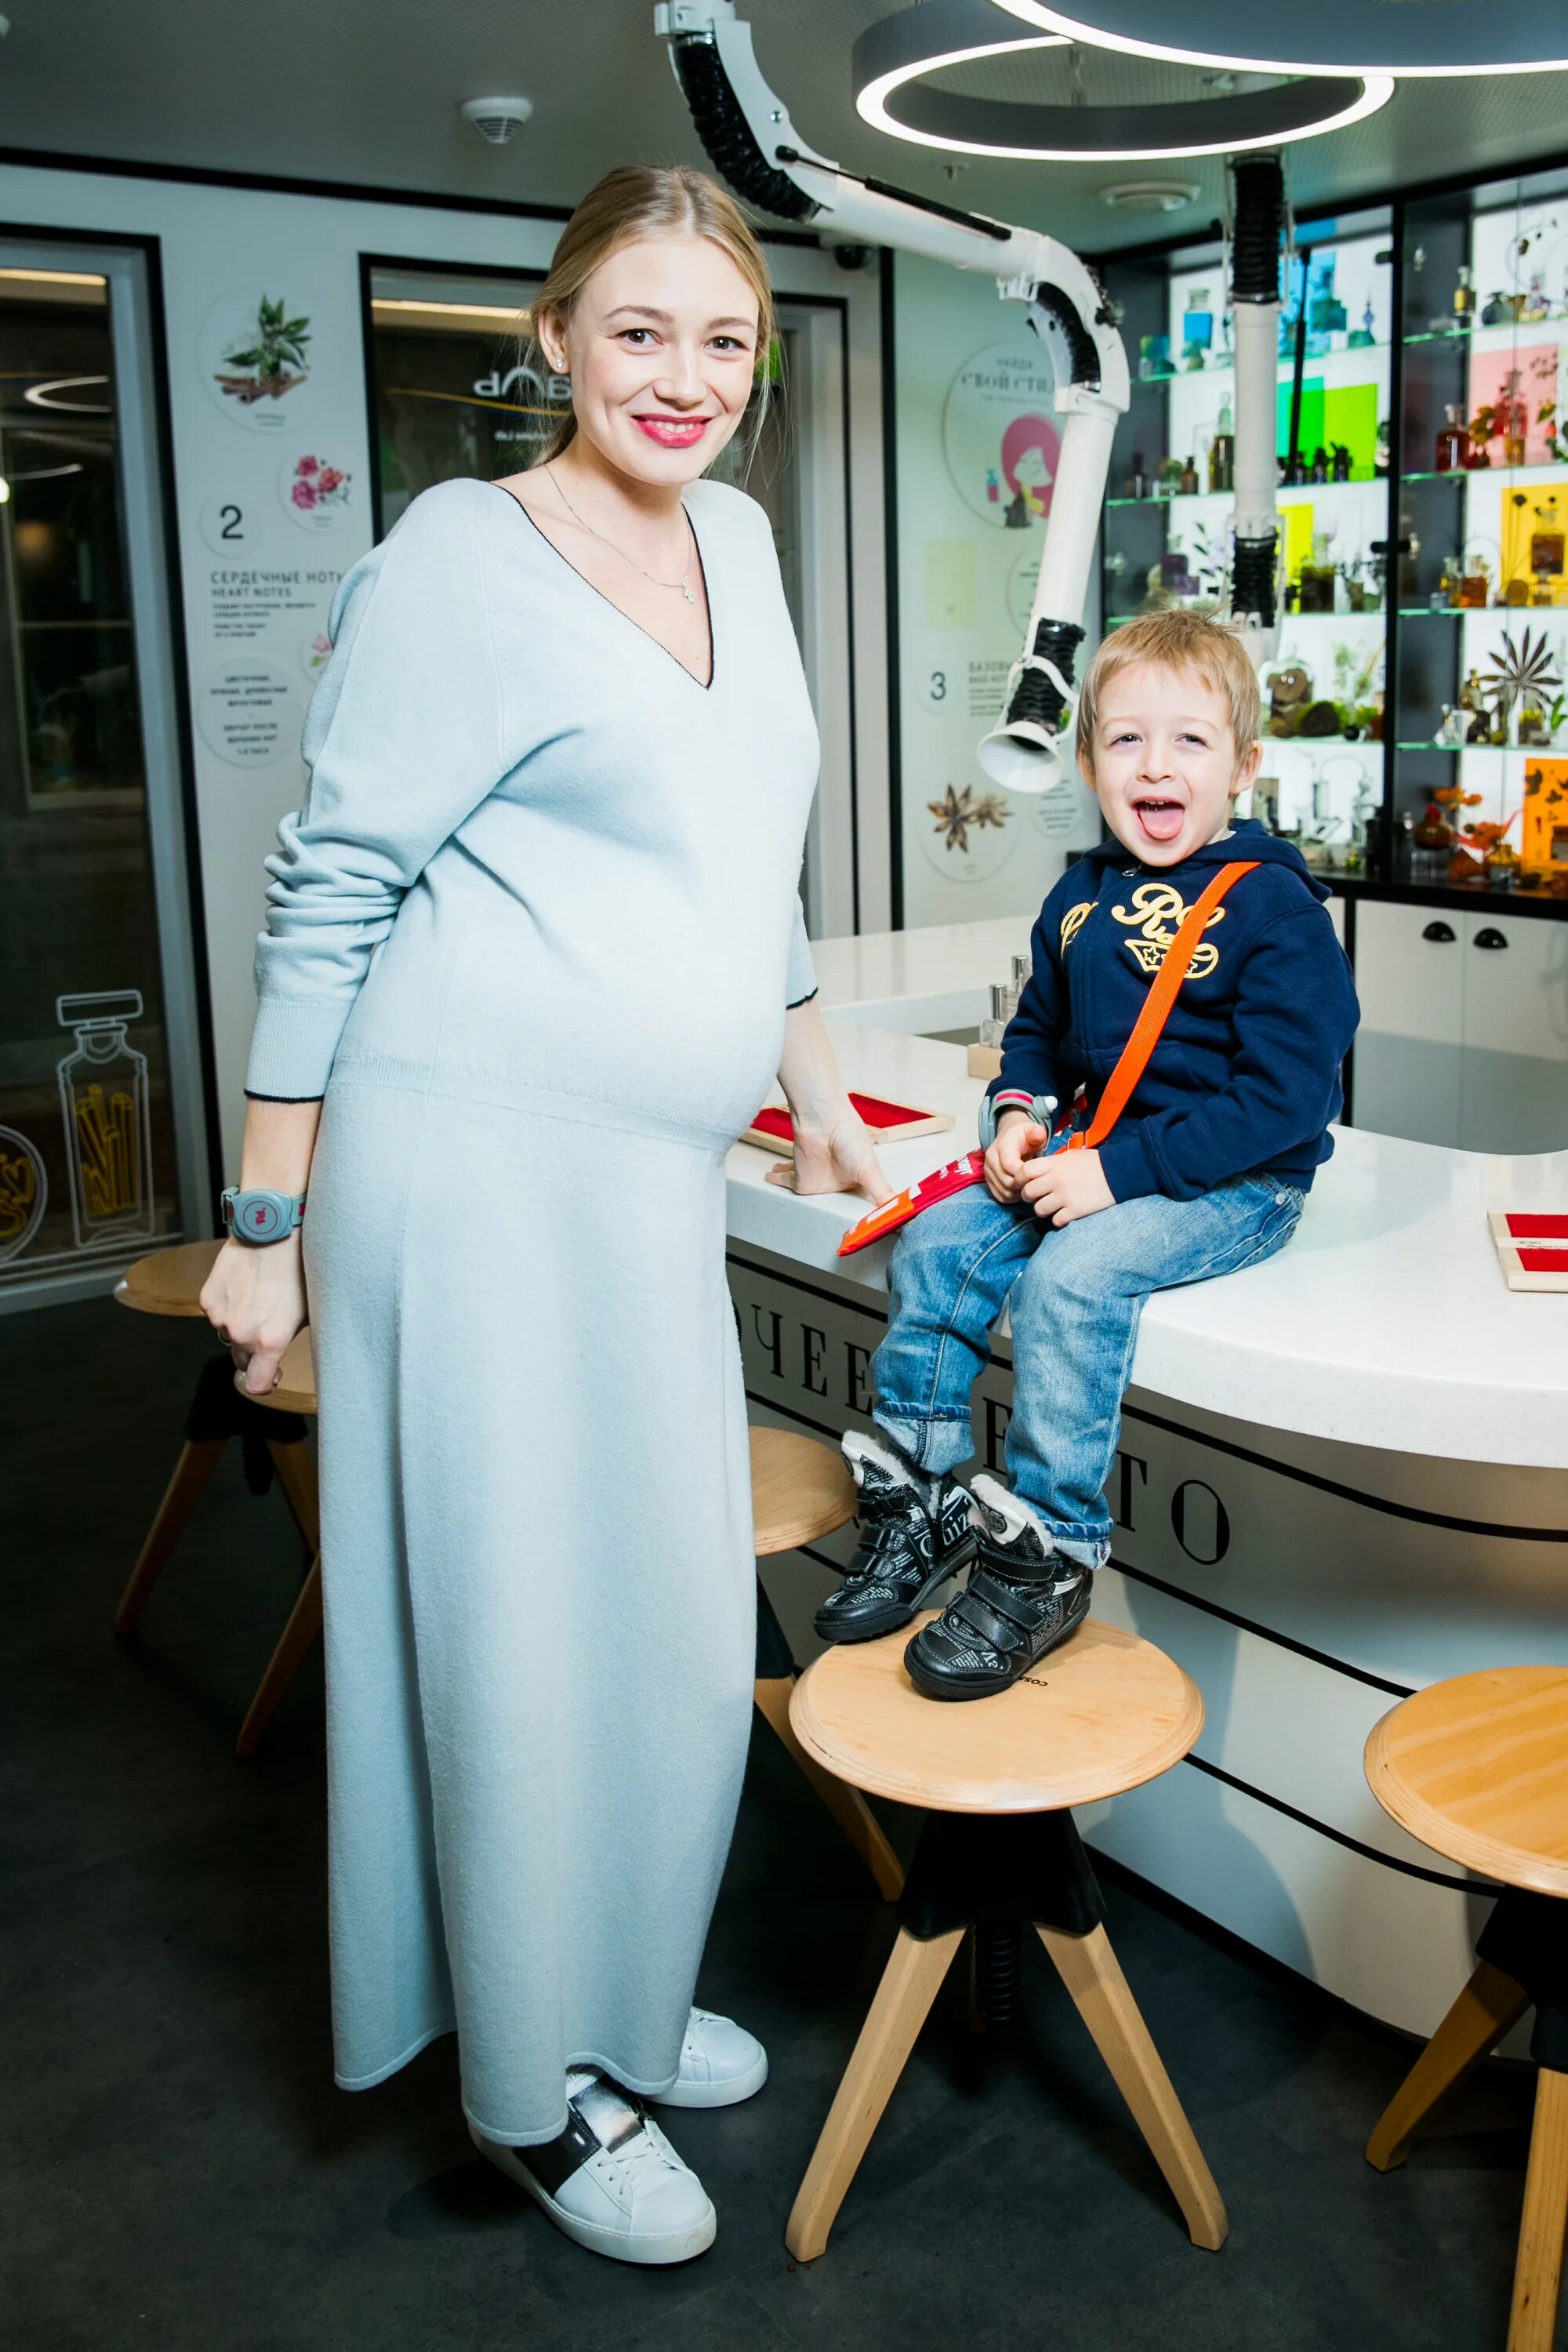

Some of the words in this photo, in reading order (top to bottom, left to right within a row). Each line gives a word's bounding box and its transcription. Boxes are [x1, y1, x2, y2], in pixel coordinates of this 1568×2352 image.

[220, 504, 244, 540] 2
[210, 571, 300, 585] СЕРДЕЧНЫЕ
[211, 587, 249, 597] HEART
[253, 586, 292, 597] NOTES
[931, 671, 946, 701] 3
[732, 1301, 873, 1417] ЧЕЕ
